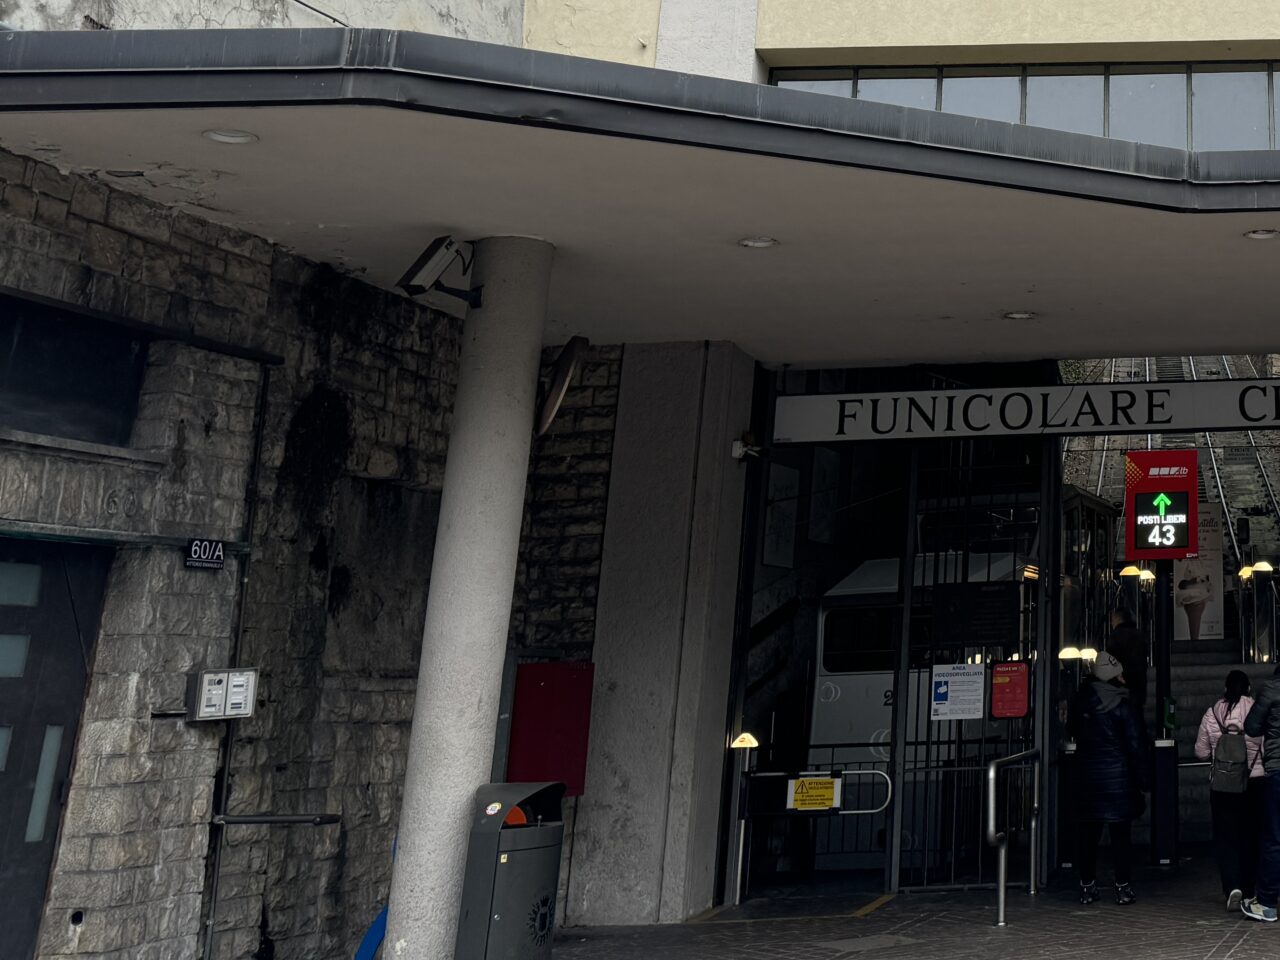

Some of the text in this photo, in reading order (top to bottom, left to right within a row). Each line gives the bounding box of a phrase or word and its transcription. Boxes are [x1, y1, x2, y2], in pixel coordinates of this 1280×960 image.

[834, 388, 1173, 436] FUNICOLARE
[1137, 515, 1160, 525] POSTI
[1161, 514, 1187, 524] LIBERI
[1147, 524, 1176, 546] 43
[191, 540, 224, 561] 60/A
